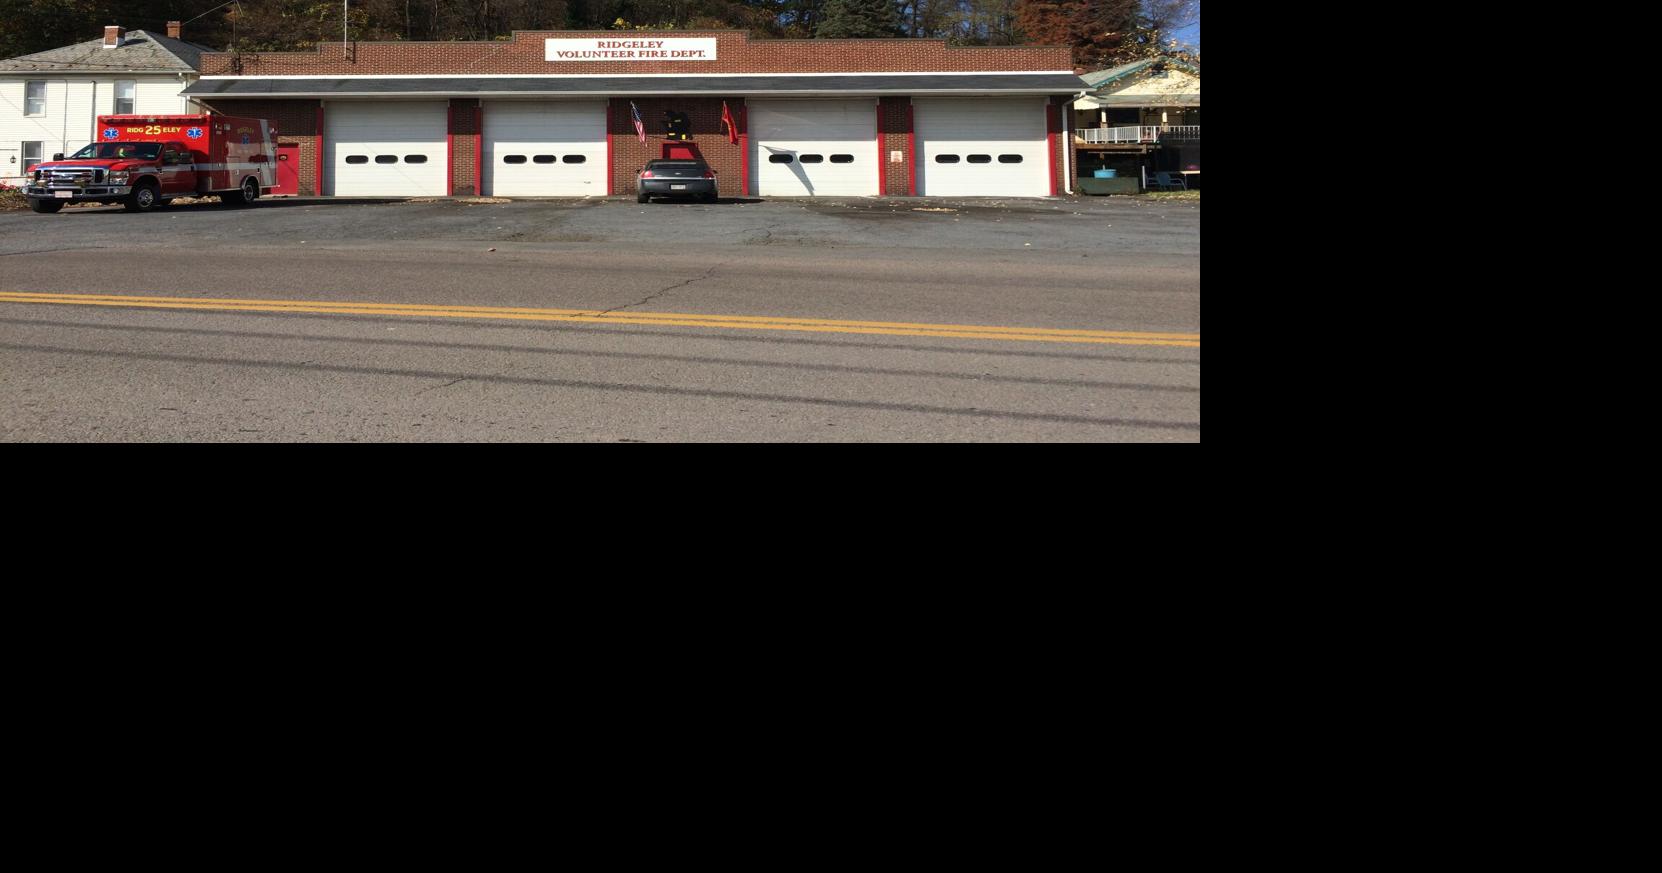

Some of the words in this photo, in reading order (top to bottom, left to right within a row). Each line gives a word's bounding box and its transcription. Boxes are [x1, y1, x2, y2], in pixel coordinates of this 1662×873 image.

[597, 41, 664, 49] RIDGELEY
[557, 50, 635, 58] VOLUNTEER
[638, 50, 668, 58] FIRE
[671, 50, 706, 58] DEPT.
[145, 125, 161, 135] 25
